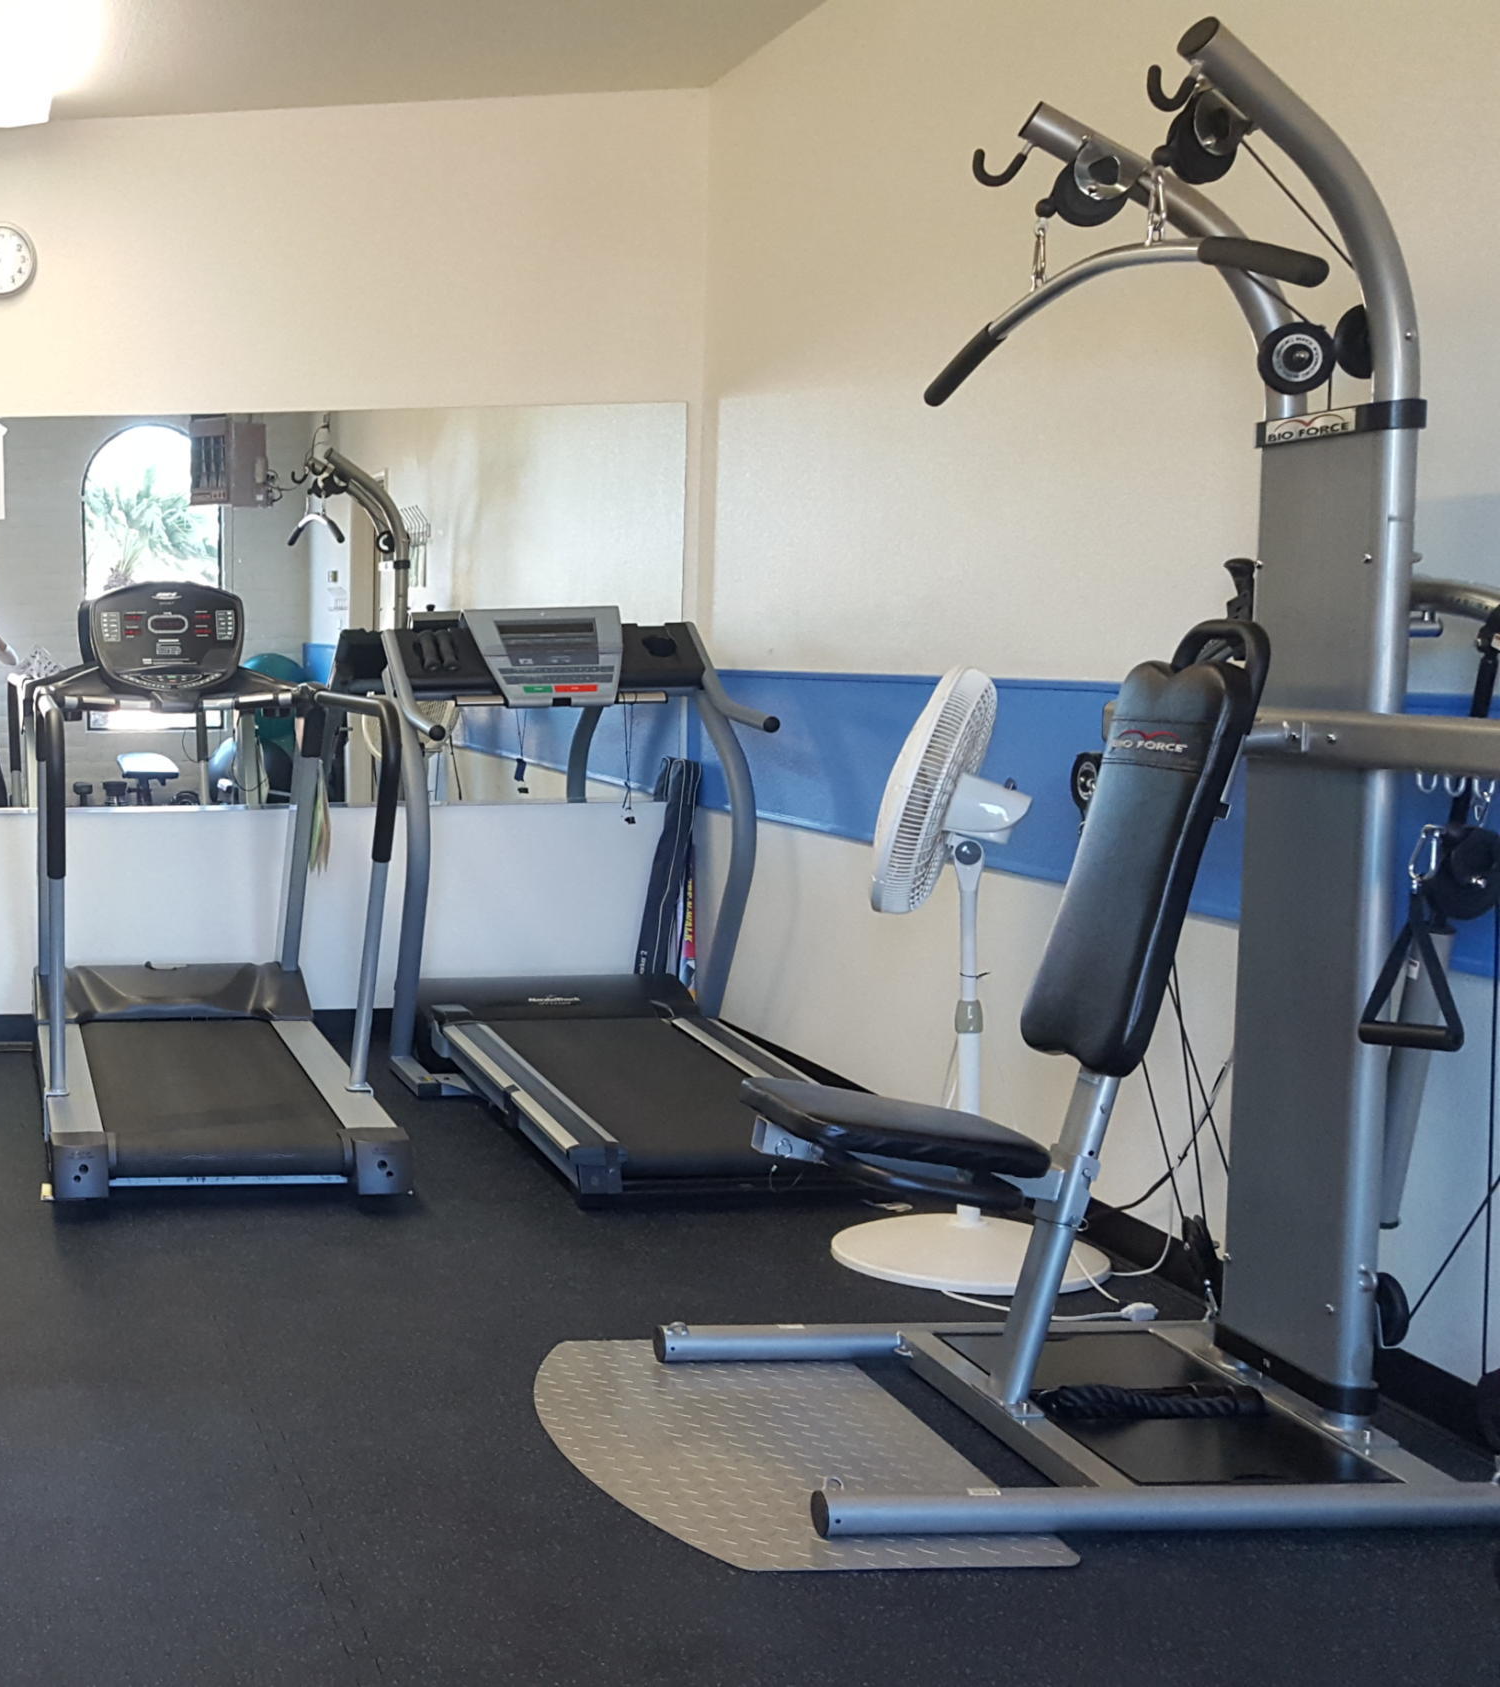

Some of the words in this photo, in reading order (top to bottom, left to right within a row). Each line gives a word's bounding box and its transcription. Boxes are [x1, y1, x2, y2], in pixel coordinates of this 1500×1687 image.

[1267, 430, 1293, 443] BIO
[1299, 421, 1350, 438] FORCE
[1136, 740, 1188, 753] FORCE
